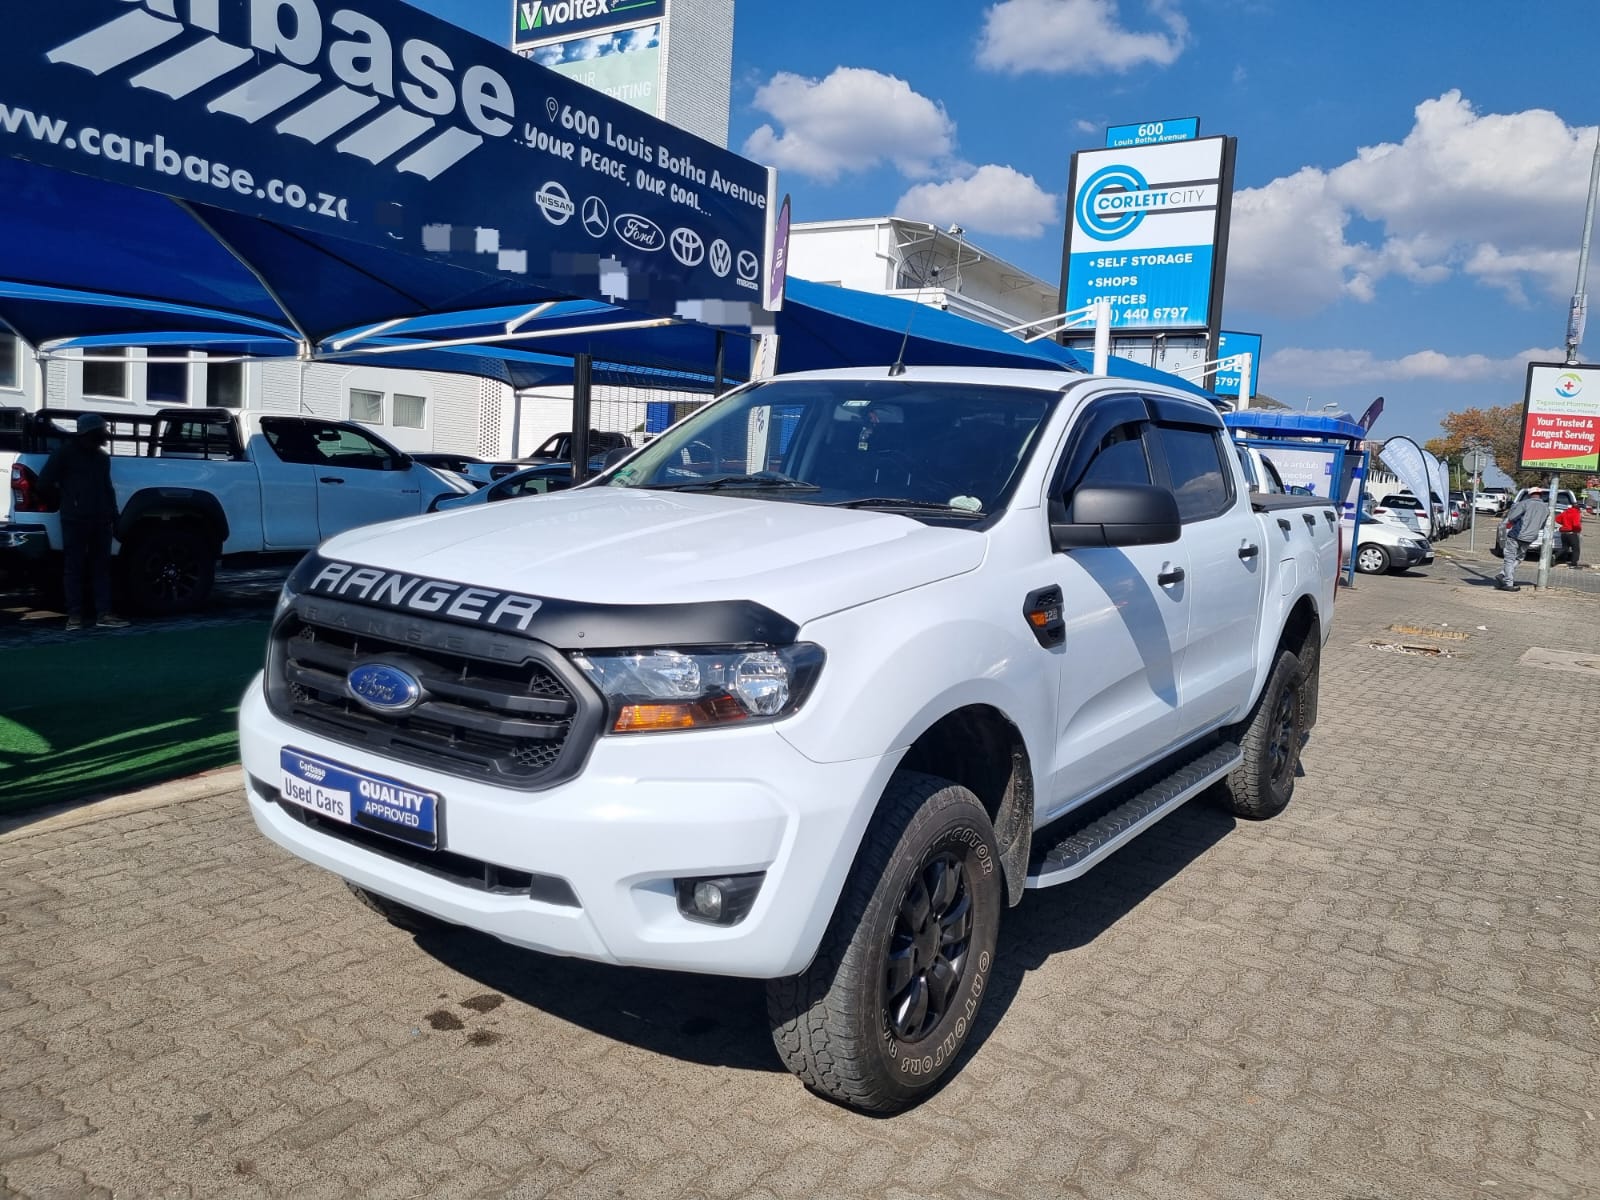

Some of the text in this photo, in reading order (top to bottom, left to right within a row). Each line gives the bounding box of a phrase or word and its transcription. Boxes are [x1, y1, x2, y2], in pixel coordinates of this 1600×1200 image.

[543, 0, 610, 26] voltex
[118, 0, 515, 137] base
[1138, 122, 1164, 137] 600
[1114, 133, 1187, 147] Louis Botha Avenue
[561, 105, 767, 210] 600 Louis Botha Avenue
[635, 168, 667, 197] OUR
[538, 195, 573, 212] NISSAN
[623, 218, 656, 246] Ford
[1096, 253, 1193, 269] SELF STORAGE
[1095, 276, 1138, 288] SHOPS
[1093, 294, 1147, 306] OFFICES
[1123, 308, 1150, 320] 440
[1153, 306, 1189, 319] 6797
[1537, 416, 1594, 429] Your Trusted &
[1532, 428, 1596, 443] Longest Serving
[1530, 439, 1594, 454] Local Pharmacy
[310, 562, 544, 632] RANGER
[299, 760, 326, 777] Carbase
[285, 777, 344, 816] Used Cars
[359, 780, 424, 812] QUALITY
[364, 801, 420, 827] APPROVED
